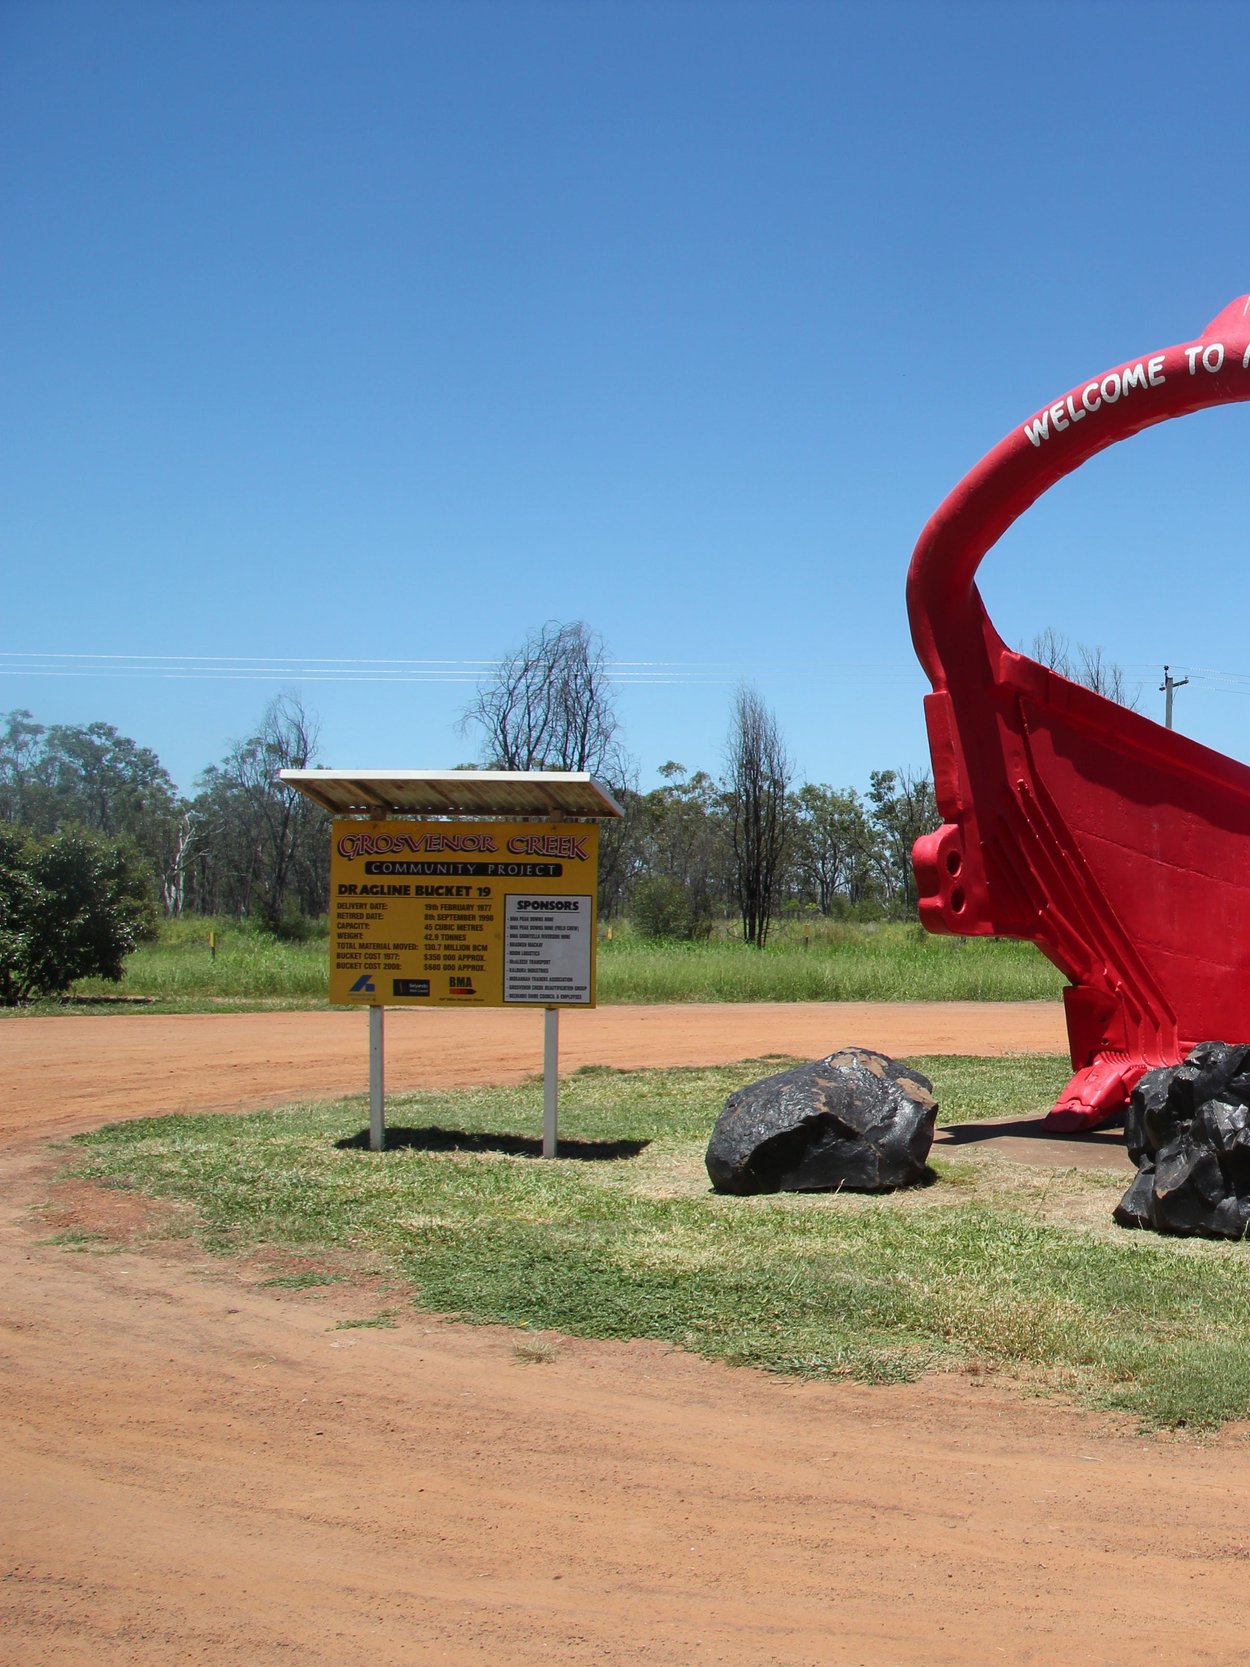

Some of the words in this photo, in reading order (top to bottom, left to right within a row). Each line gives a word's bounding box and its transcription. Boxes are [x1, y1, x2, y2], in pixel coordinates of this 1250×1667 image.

[1023, 354, 1166, 448] WELCOME
[1184, 342, 1225, 376] TO
[338, 834, 498, 859] GROSVENOR
[507, 835, 590, 861] CREEK
[371, 862, 477, 874] COMMUNITY
[487, 864, 556, 876] PROJECT
[338, 884, 411, 896] DRAGLINE
[415, 885, 473, 896] BUCKET
[477, 886, 492, 897] 19
[517, 900, 579, 910] SPONSORS
[449, 977, 472, 988] BMA
